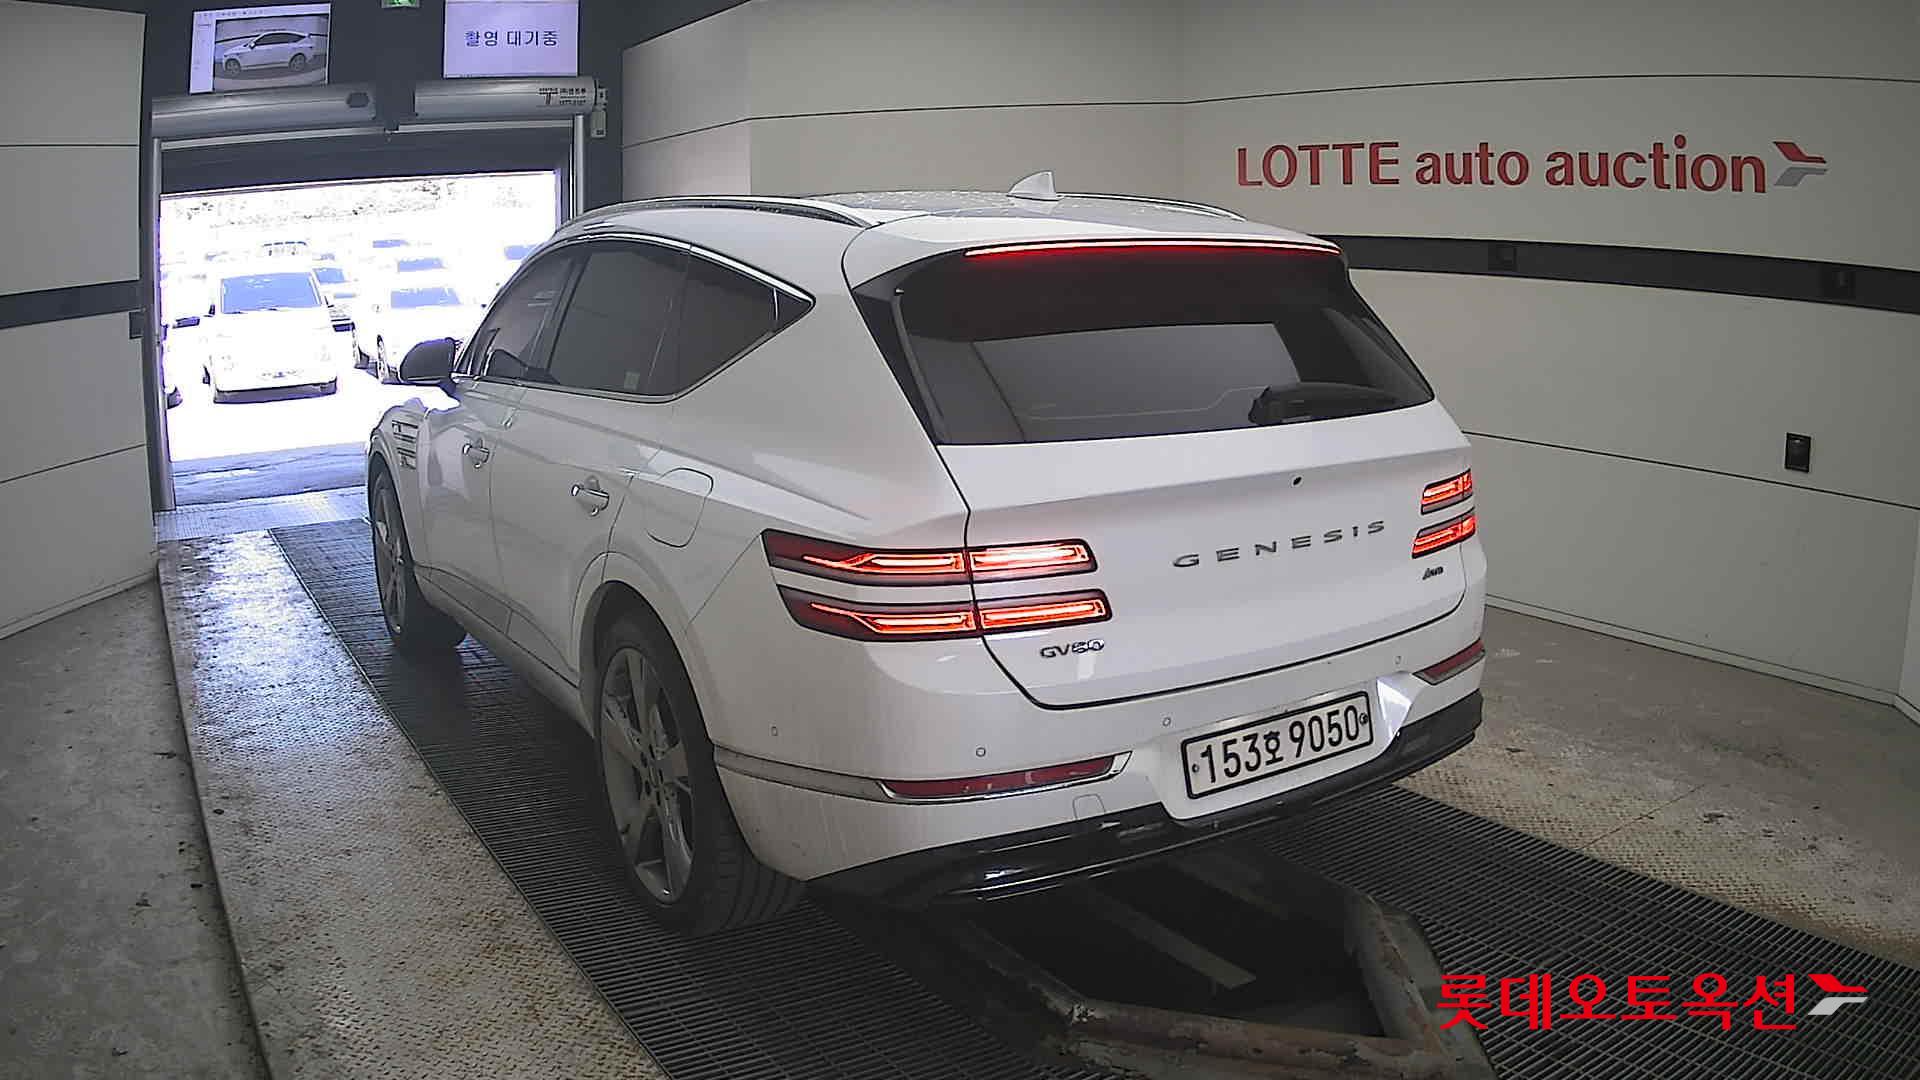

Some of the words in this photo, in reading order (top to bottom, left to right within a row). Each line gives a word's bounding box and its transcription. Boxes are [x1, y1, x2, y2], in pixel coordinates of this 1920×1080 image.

[507, 30, 557, 46] 대기중
[1237, 142, 1399, 188] LOTTE
[1415, 141, 1529, 186] auto
[1545, 134, 1767, 193] auction
[1173, 521, 1385, 568] GENESIS
[1040, 639, 1105, 658] GV80
